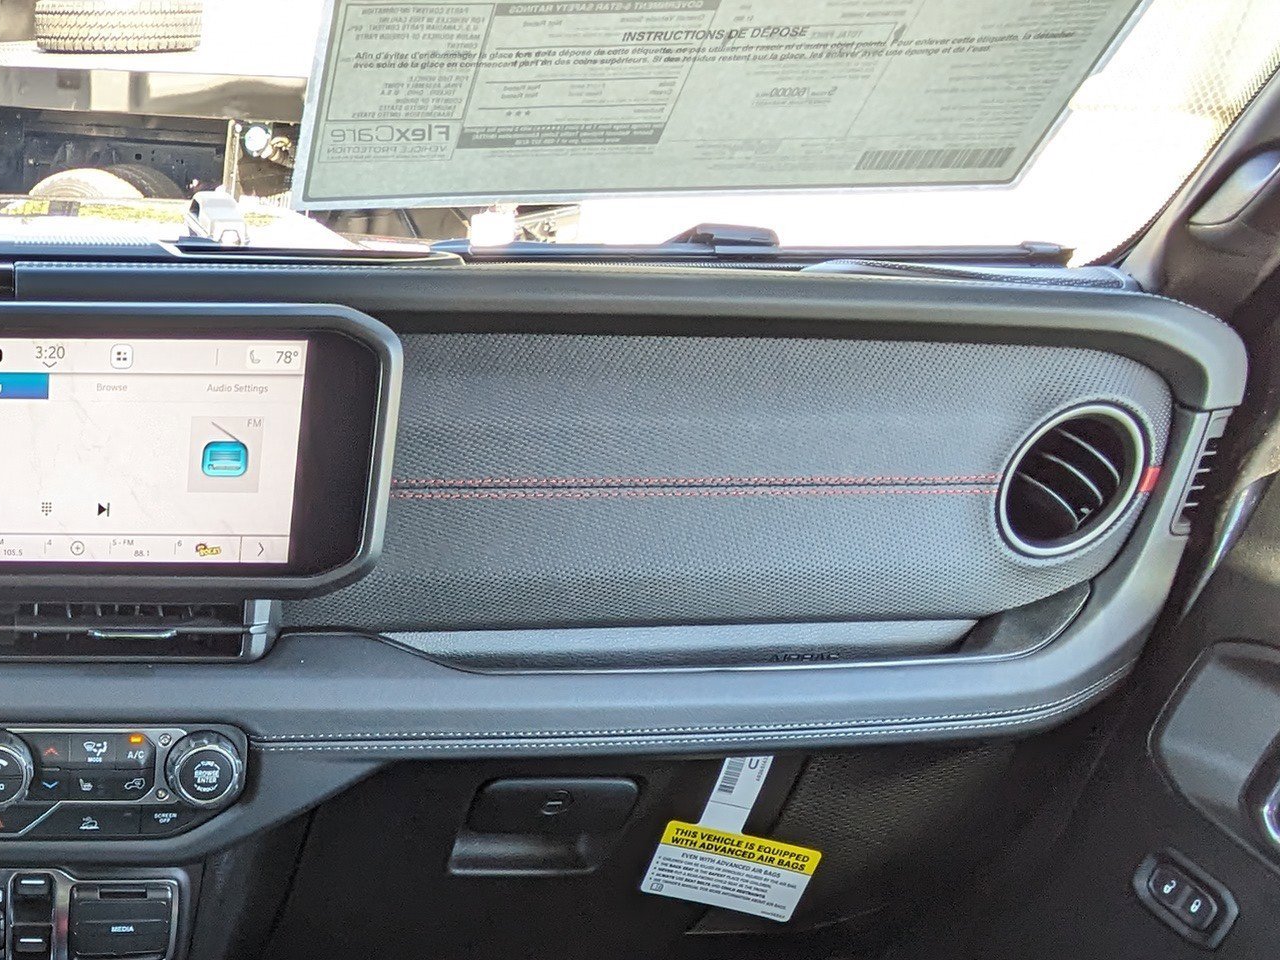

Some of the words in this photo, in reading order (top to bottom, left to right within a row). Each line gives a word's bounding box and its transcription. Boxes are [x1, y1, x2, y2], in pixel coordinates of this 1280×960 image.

[621, 30, 724, 42] INSTRUCTIONS
[728, 28, 747, 39] DE
[750, 25, 809, 38] DÉPOSE
[35, 345, 66, 359] 3:20
[275, 350, 299, 364] 78°
[96, 383, 128, 392] Browse
[206, 384, 232, 393] Audio
[233, 384, 269, 394] Settings
[246, 418, 263, 428] FM
[46, 539, 52, 547] 4
[177, 539, 183, 547] 6
[3, 548, 23, 556] 105.5
[770, 652, 840, 662] AIRBAG
[127, 750, 145, 760] A/C
[675, 827, 699, 839] THIS
[700, 832, 744, 850] VEHICLE
[745, 842, 755, 851] IS
[757, 844, 810, 863] EQUIPPED
[671, 836, 697, 849] WITH
[698, 842, 756, 861] ADVANCED
[757, 854, 776, 866] AIR
[777, 858, 807, 872] BAGS
[716, 858, 751, 873] ADVANCED
[763, 868, 781, 879] BAGS
[110, 925, 135, 933] MEDIA
